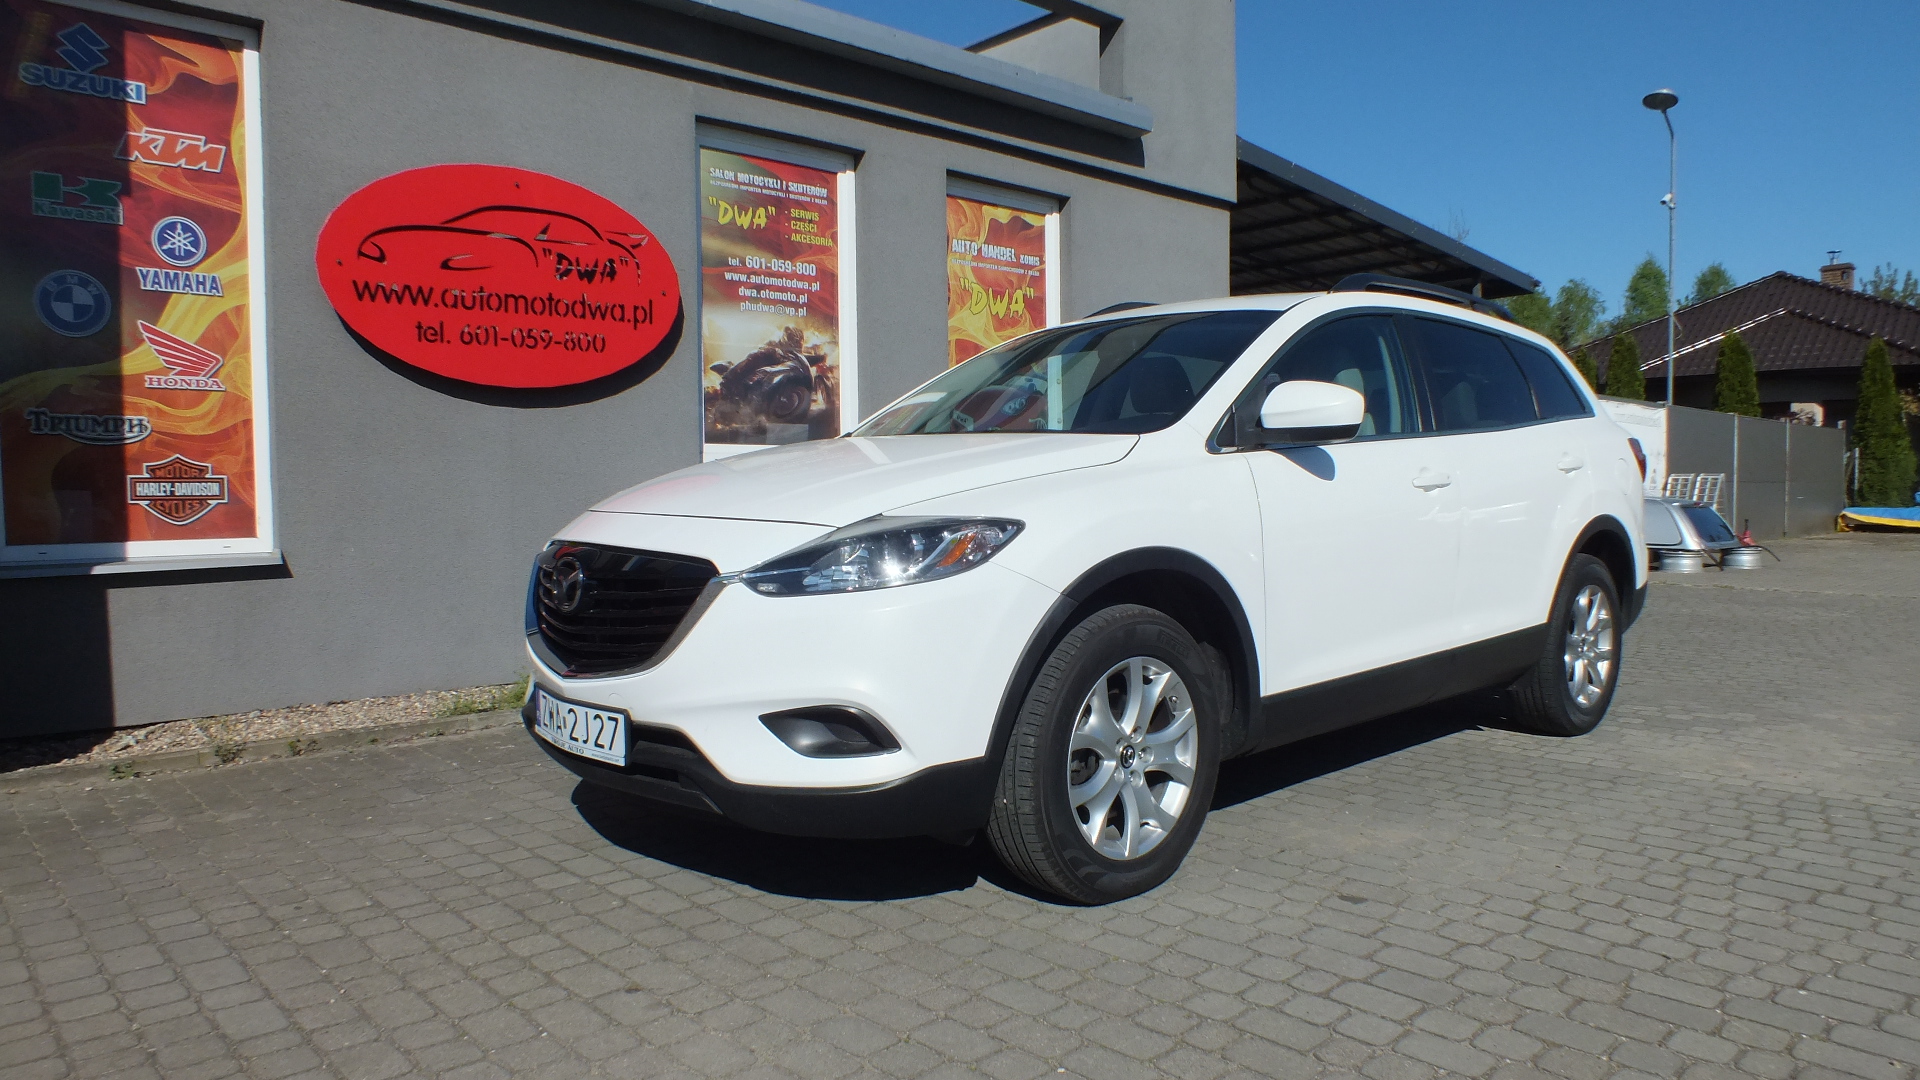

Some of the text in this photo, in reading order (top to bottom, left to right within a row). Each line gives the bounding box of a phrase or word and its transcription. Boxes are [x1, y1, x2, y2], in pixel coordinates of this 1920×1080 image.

[19, 62, 146, 104] SUZUKI
[113, 127, 226, 173] KTM
[709, 167, 735, 181] SALON
[737, 172, 781, 190] MOTOCYKLI
[788, 184, 828, 198] SKUTERÓW
[33, 201, 123, 225] Kawasaki
[791, 208, 819, 221] SERWIS
[791, 221, 817, 233] CZĘŚCI
[791, 234, 833, 247] AKCESORIA
[952, 238, 1040, 267] AUTO HANDEL KOMIS
[728, 255, 816, 277] tel. 601-059-800
[136, 267, 222, 296] YAMAHA
[724, 271, 820, 292] www.automotodwa.pl
[352, 279, 653, 330] www.automotodwa.pl
[738, 286, 808, 303] dwa.otomoto.pl
[740, 301, 807, 317] phudwa@vp.pl
[415, 320, 606, 354] tel. 601-059-800
[145, 375, 225, 390] HONDA
[25, 407, 151, 442] TRIUMPH
[154, 467, 203, 478] MOTOR
[136, 482, 220, 496] HARLEY-DAVIDSON
[156, 501, 200, 517] CYCLES
